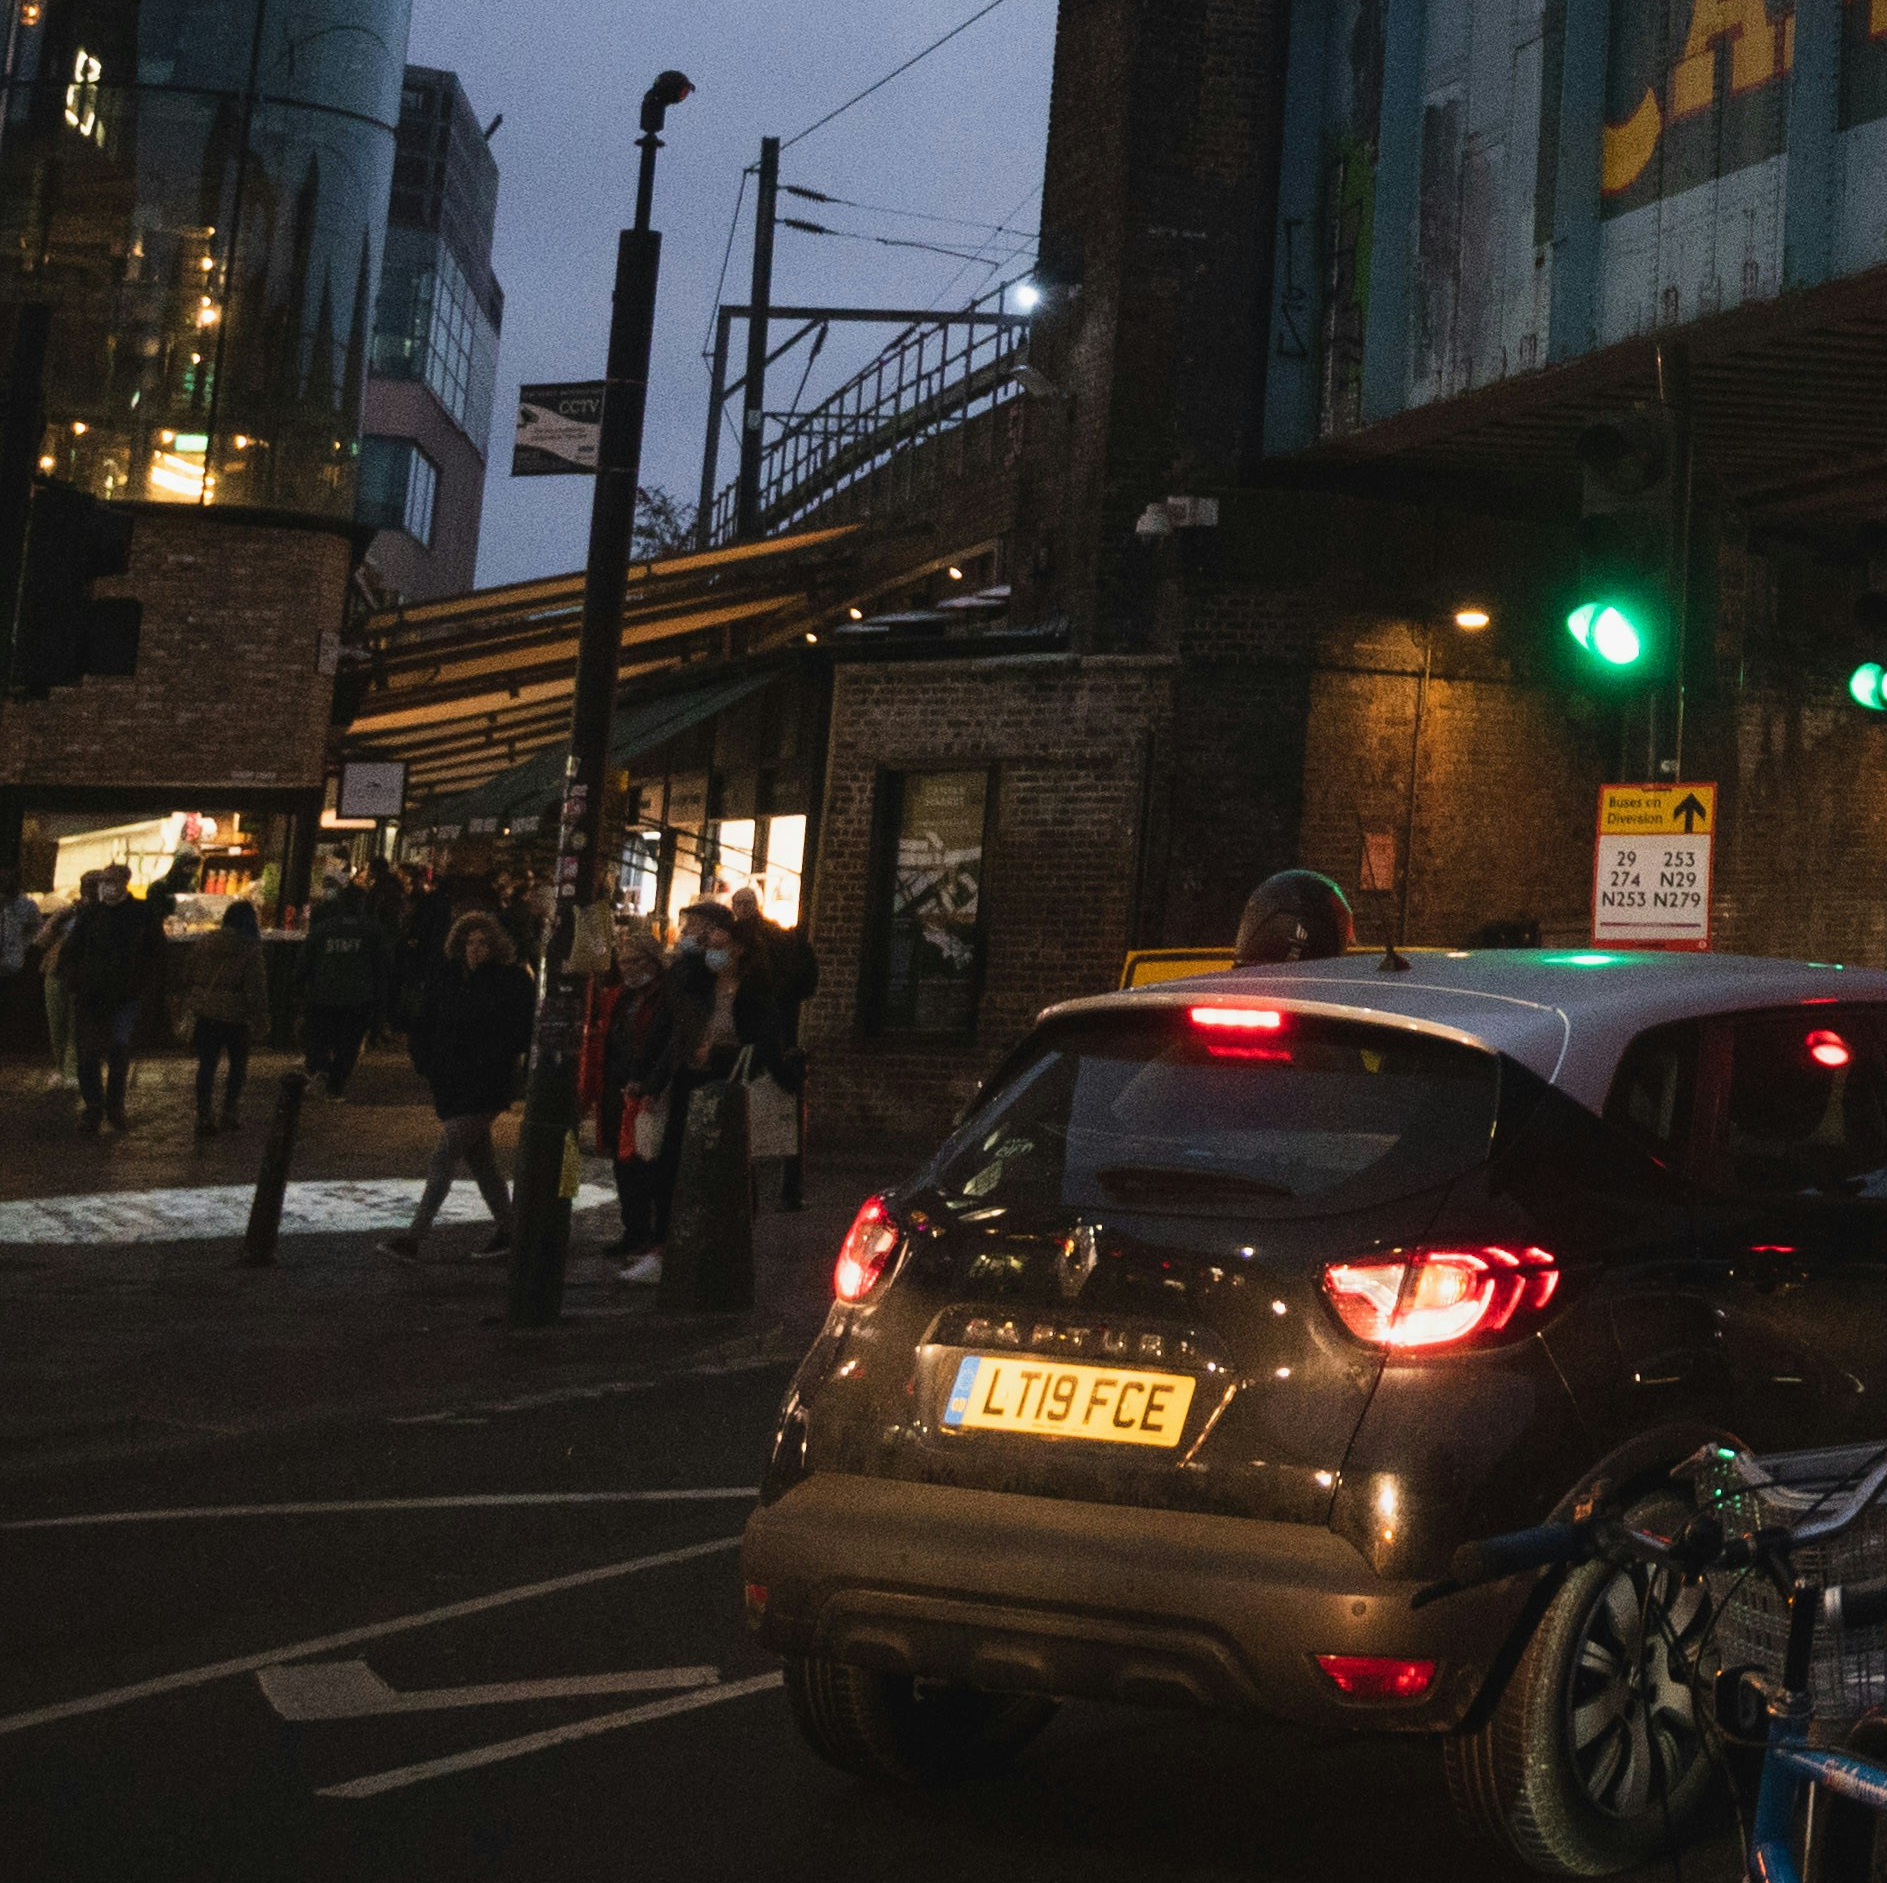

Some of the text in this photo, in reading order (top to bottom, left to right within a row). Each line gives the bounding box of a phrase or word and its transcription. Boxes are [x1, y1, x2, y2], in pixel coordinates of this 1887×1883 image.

[558, 398, 600, 415] CCTV
[1608, 795, 1662, 808] Buses on
[1607, 811, 1664, 825] Diversion
[1616, 851, 1696, 867] 29 253
[1610, 871, 1697, 888] 274 N29
[1601, 892, 1701, 908] N253 N279
[326, 938, 363, 953] STAFF
[982, 1368, 1176, 1432] LT19 FCE
